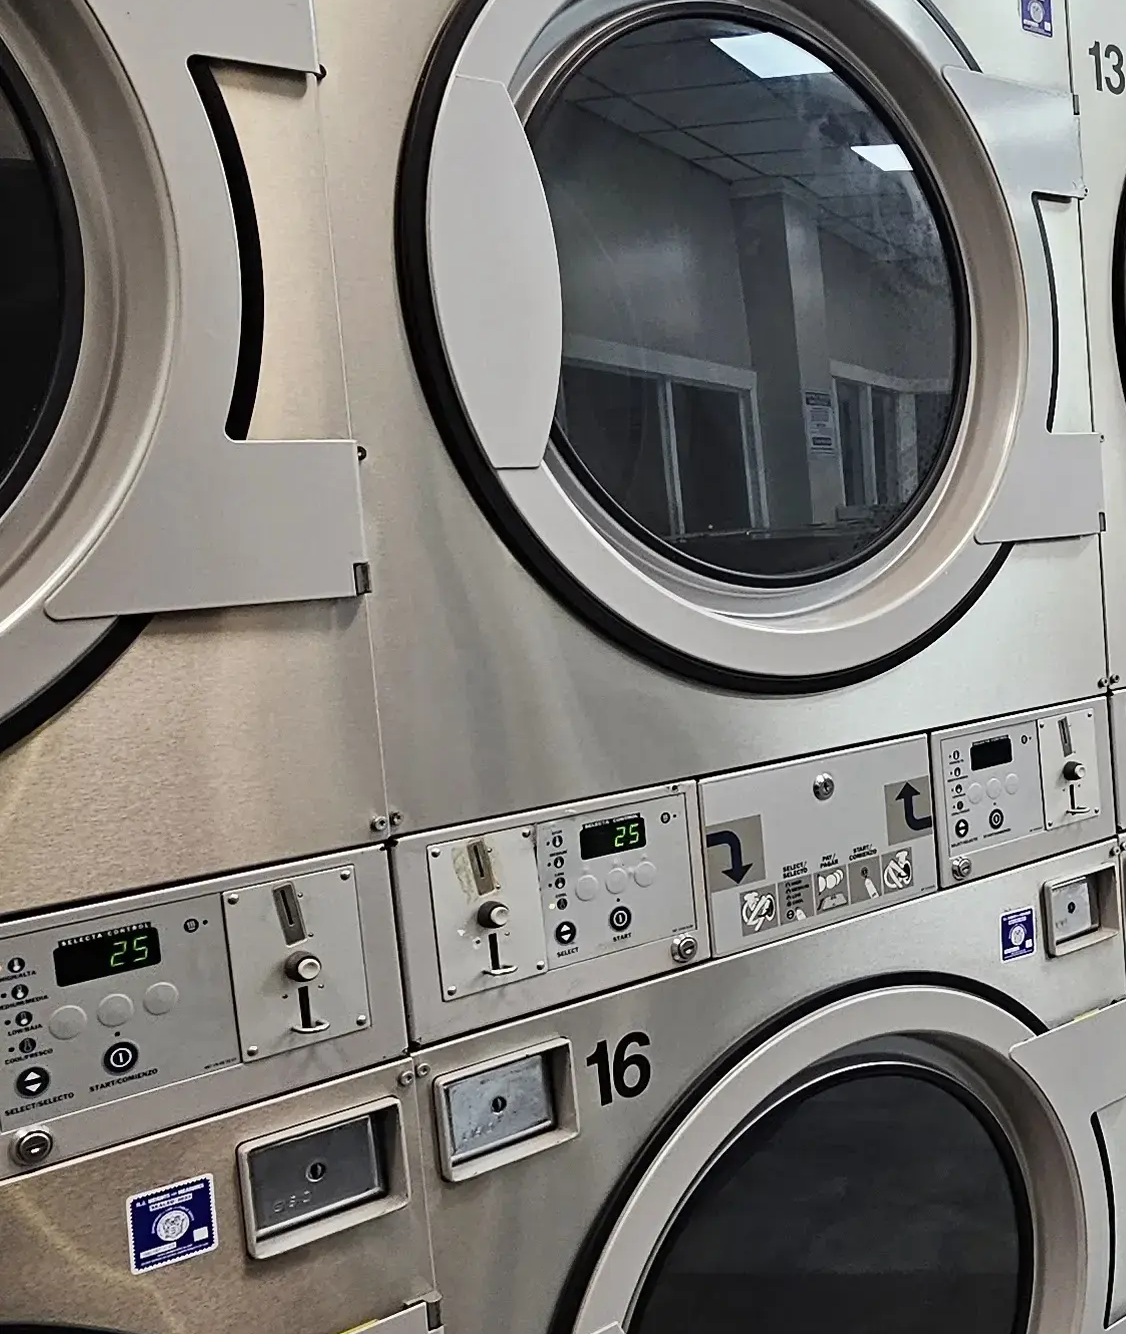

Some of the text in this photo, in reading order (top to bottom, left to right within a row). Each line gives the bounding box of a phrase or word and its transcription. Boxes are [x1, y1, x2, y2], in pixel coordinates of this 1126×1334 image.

[1088, 41, 1125, 95] 13
[615, 823, 639, 847] 25
[61, 922, 149, 947] SELECTA CONTROL
[612, 932, 632, 942] START
[110, 935, 148, 967] 25
[557, 947, 579, 958] SELECT
[89, 1068, 158, 1092] START/COMIENZO
[586, 1031, 651, 1106] 16
[4, 1092, 75, 1117] SELECT/SELECTO
